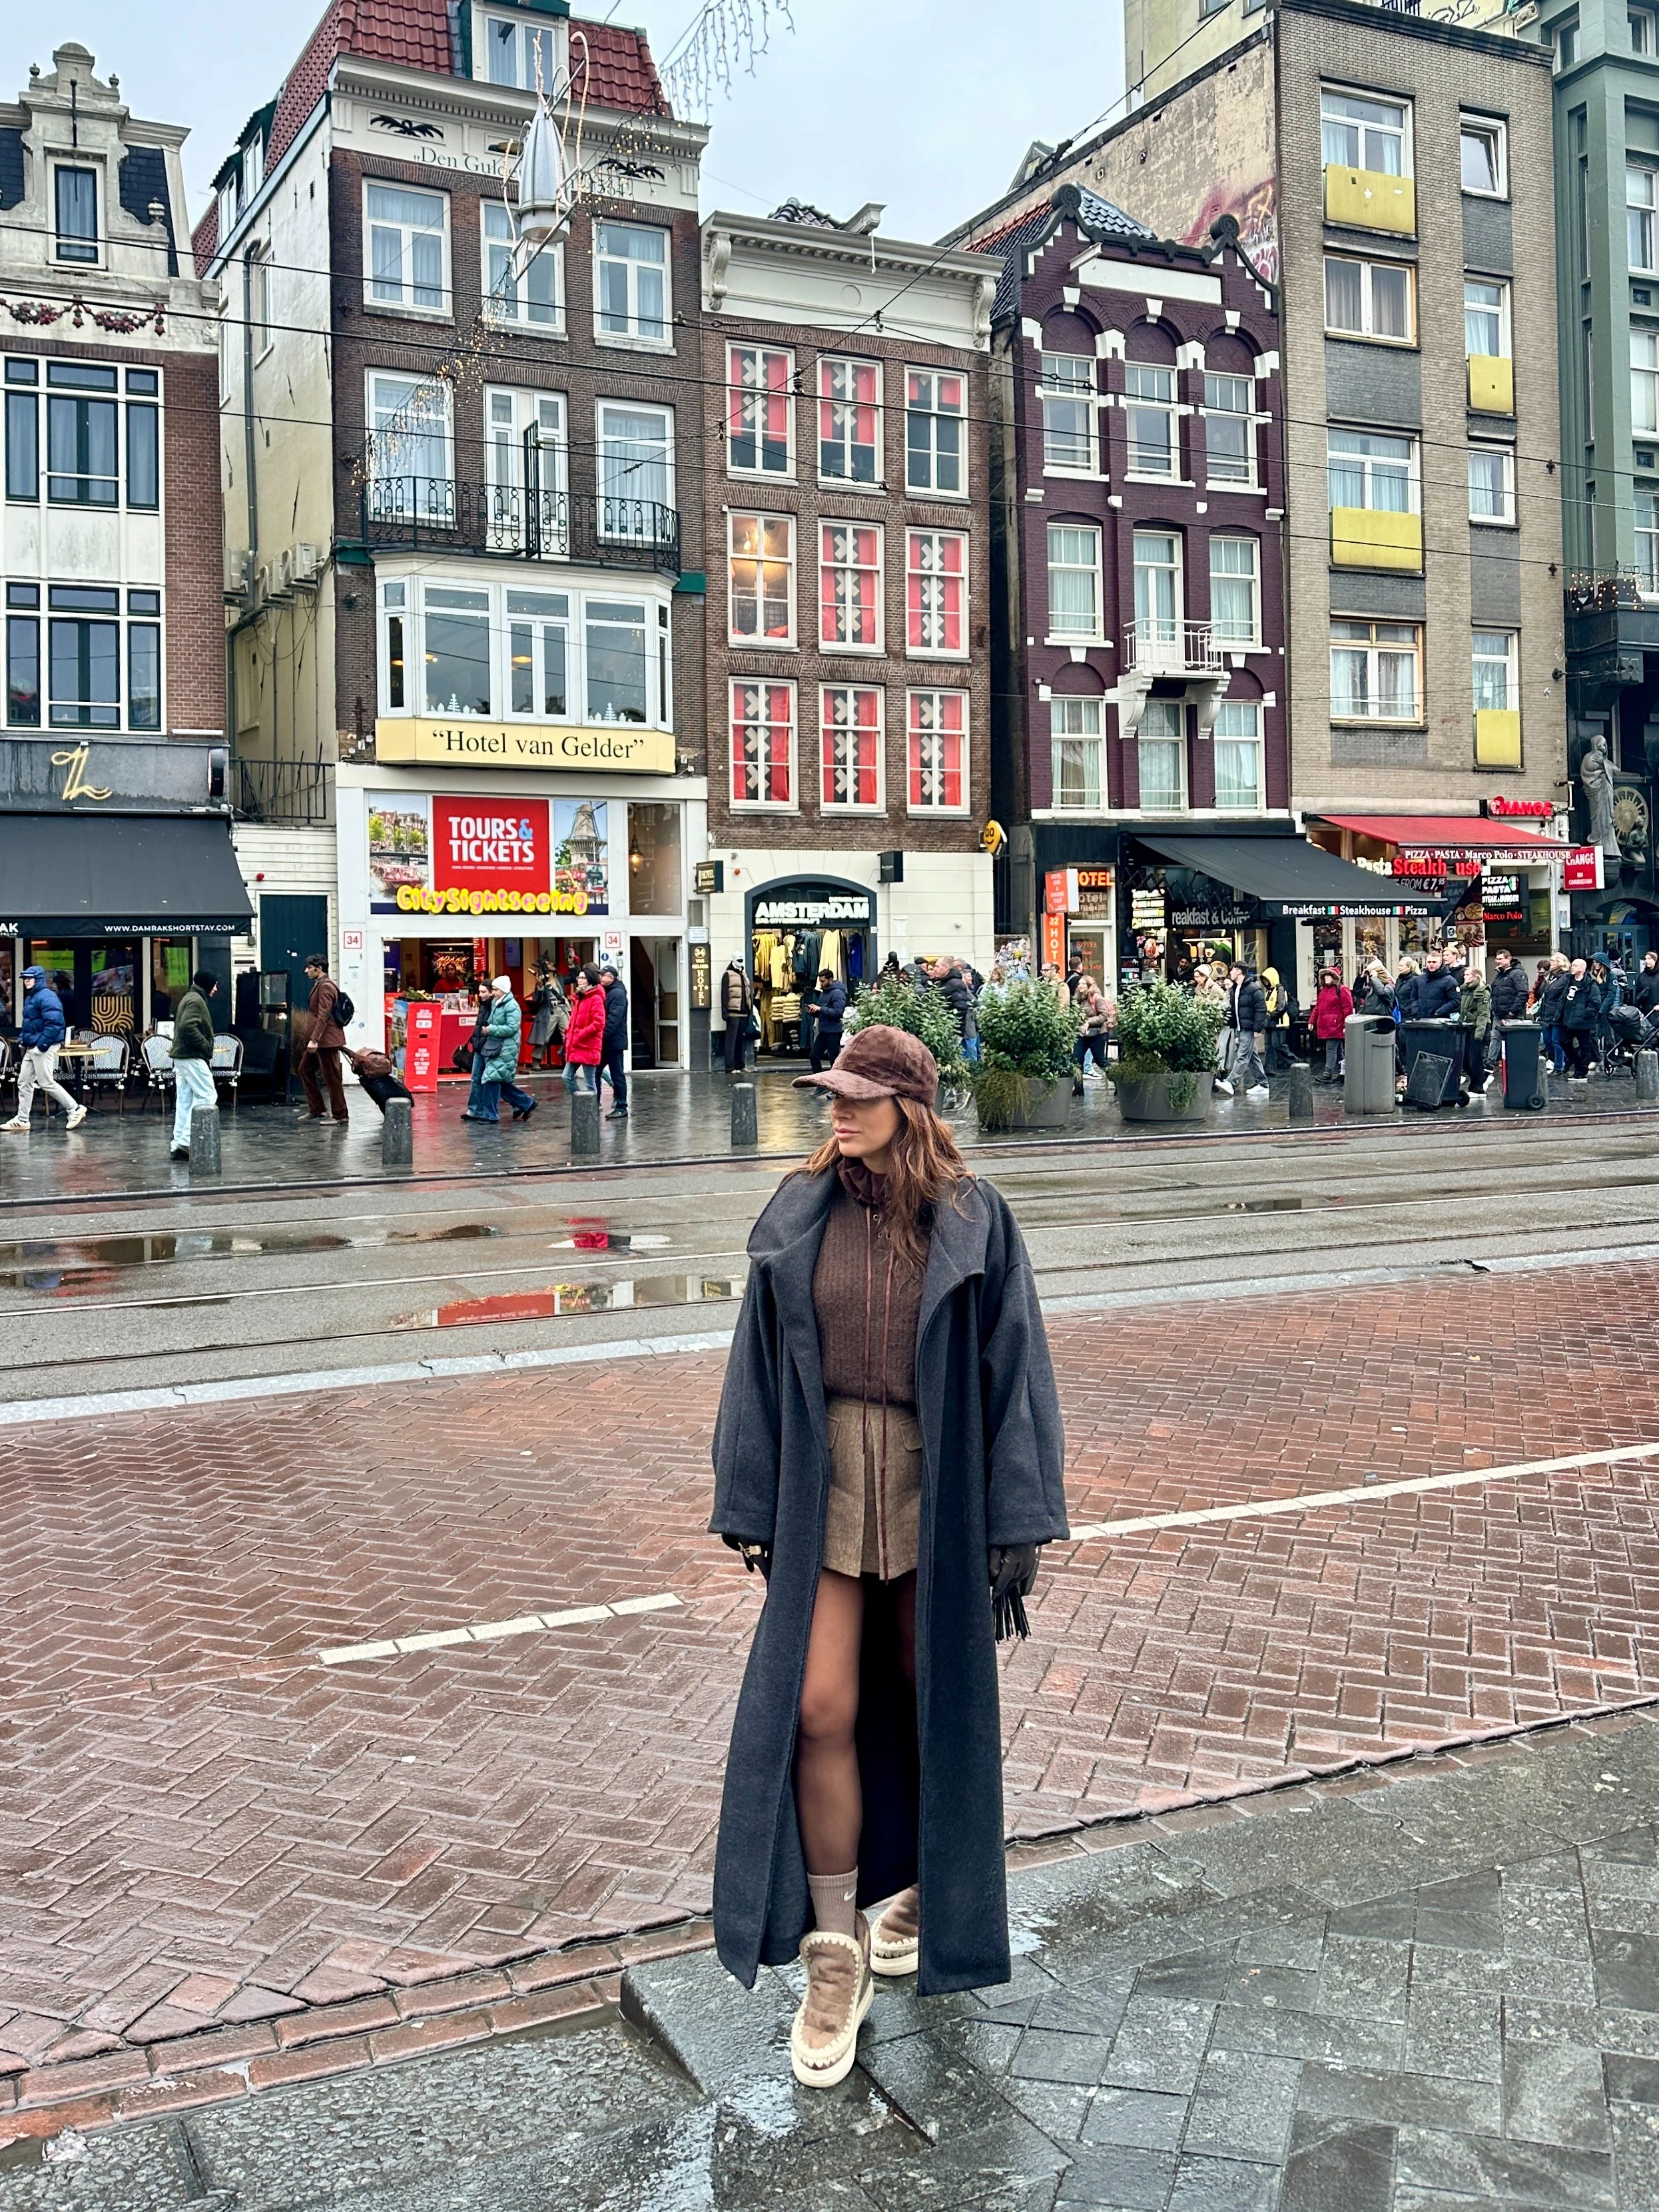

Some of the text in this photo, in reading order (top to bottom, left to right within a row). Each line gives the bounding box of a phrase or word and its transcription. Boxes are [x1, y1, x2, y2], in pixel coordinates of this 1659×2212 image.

[515, 739, 554, 755] van
[1491, 796, 1552, 816] CHANGE
[449, 839, 535, 863] TICKETS
[1405, 850, 1571, 859] PIZZA PASTA Marco Polo STEAKHOUSE
[1357, 857, 1393, 876] Pasta
[1078, 871, 1115, 887] OTEL
[1401, 879, 1422, 891] FROM
[1482, 876, 1509, 885] PIZZA
[1482, 885, 1512, 895] PASTA
[397, 885, 588, 915] CitySightseeing
[755, 902, 869, 919] AMSTERDAM
[1171, 907, 1209, 925] reakfast
[1282, 905, 1428, 915] Breakfast Steakhouse Pizza
[104, 924, 235, 932] WWW.DAMRAKSHORTSTAY.COM
[1049, 917, 1059, 925] 32
[346, 935, 359, 944] 34
[607, 936, 618, 944] 34
[696, 969, 705, 1006] HOTEL
